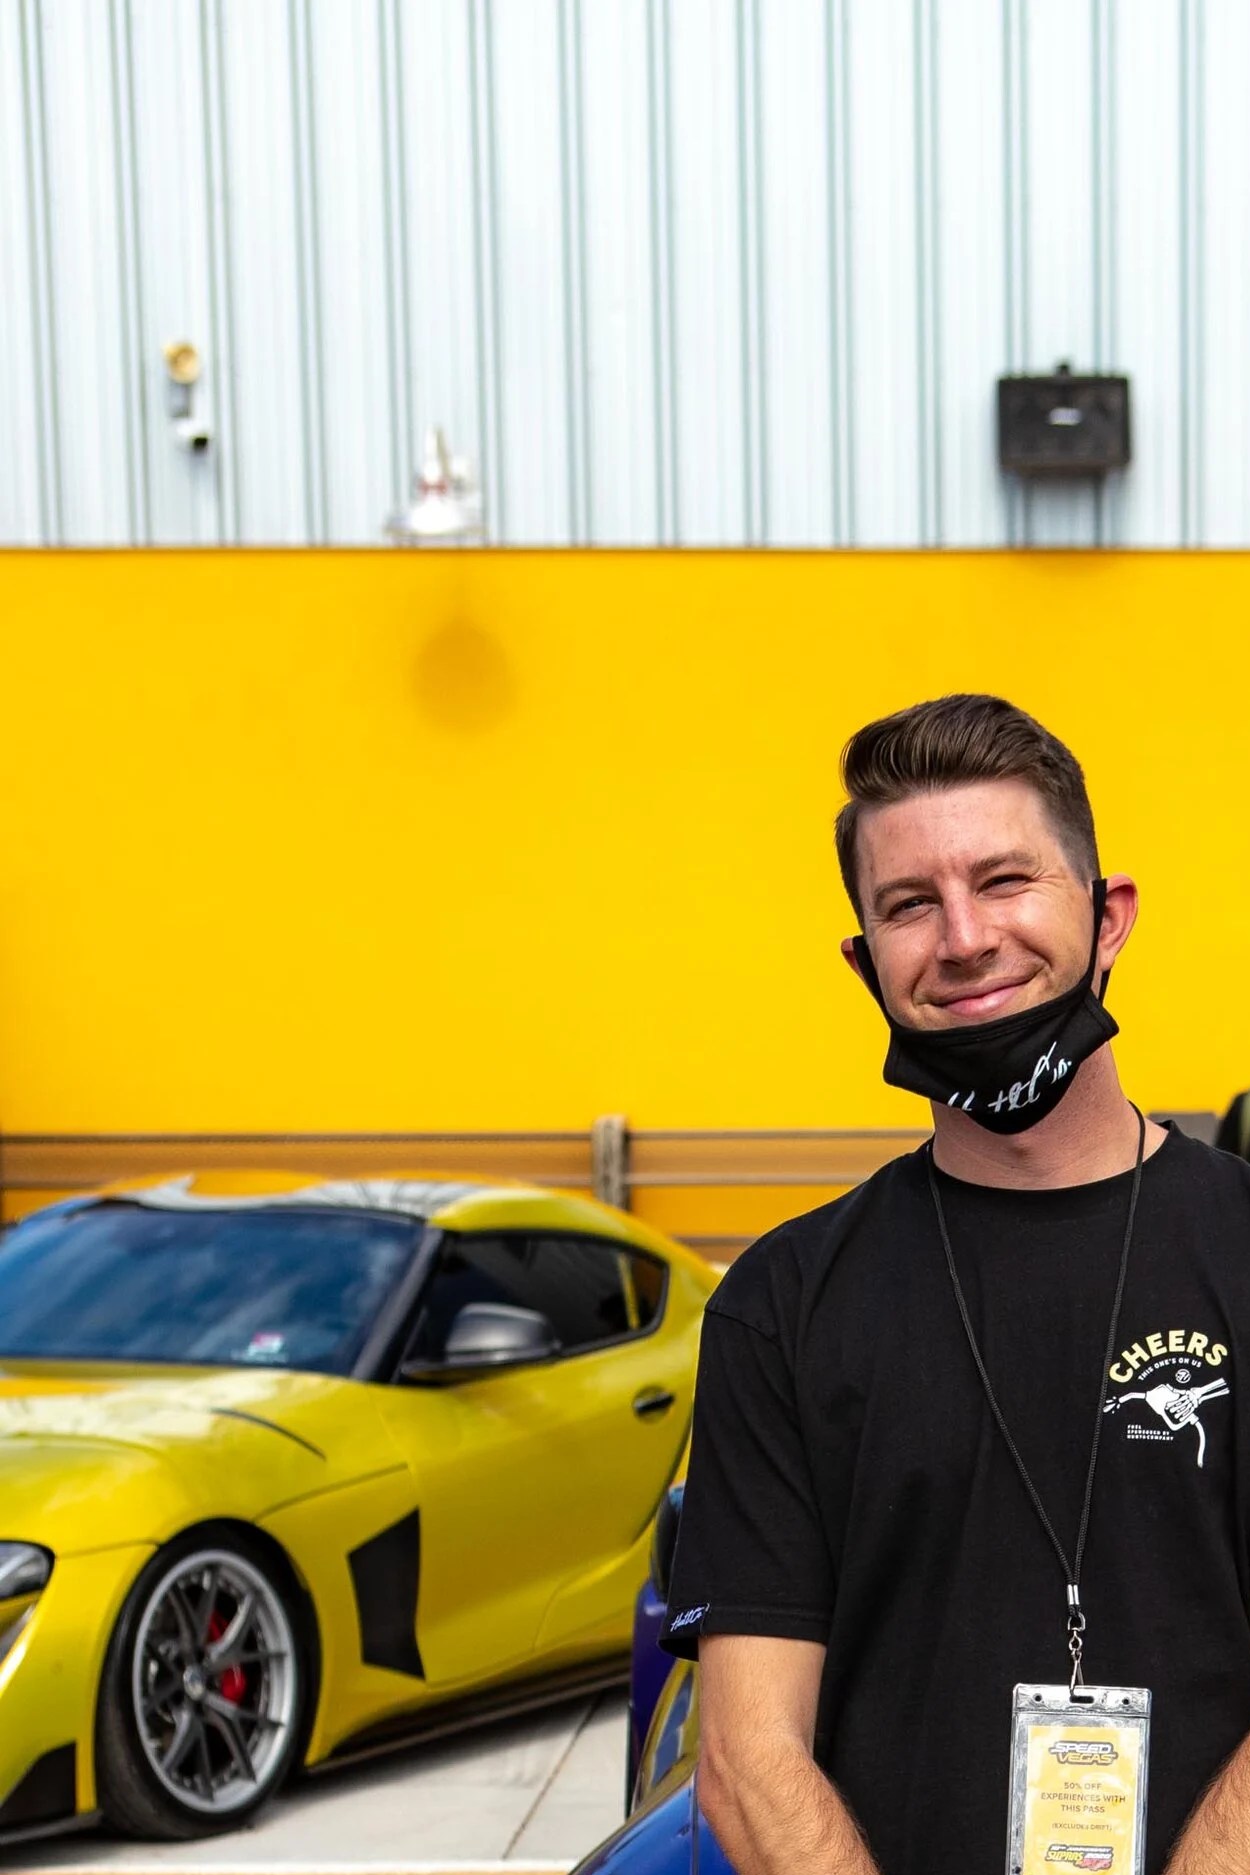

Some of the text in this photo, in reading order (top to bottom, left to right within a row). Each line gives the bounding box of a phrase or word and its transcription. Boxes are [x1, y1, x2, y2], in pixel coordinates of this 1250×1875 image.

[1109, 1330, 1228, 1383] CHEERS
[1138, 1366, 1154, 1380] THIS
[1154, 1357, 1177, 1369] ONE'S
[1191, 1359, 1202, 1368] US
[1050, 1742, 1112, 1754] SPEED
[1058, 1752, 1116, 1764] VEGAS
[1064, 1782, 1103, 1791] 50% OFF
[1041, 1792, 1126, 1803] EXPERIENCES WITH
[1061, 1804, 1105, 1813] THIS PASS
